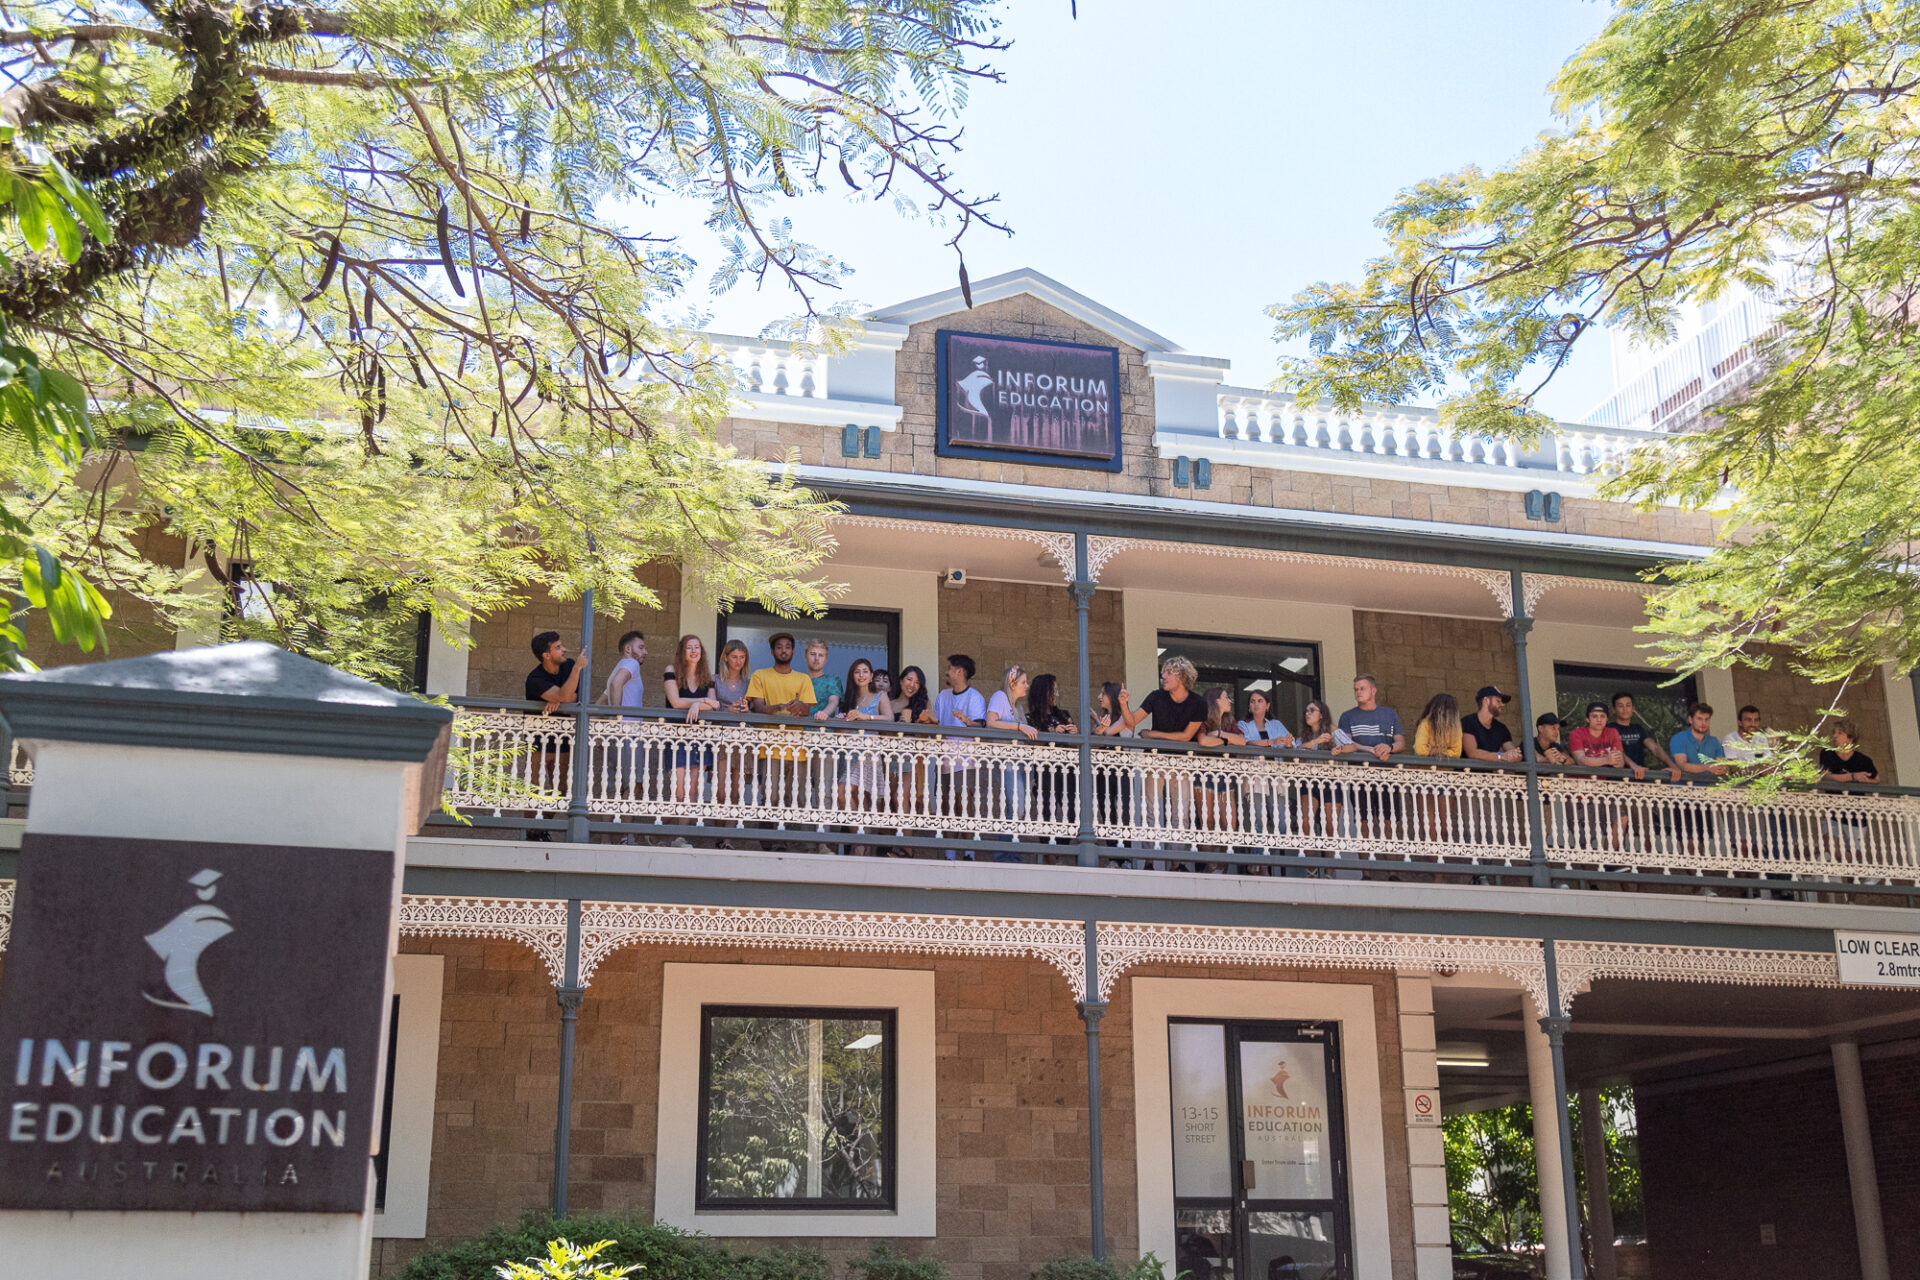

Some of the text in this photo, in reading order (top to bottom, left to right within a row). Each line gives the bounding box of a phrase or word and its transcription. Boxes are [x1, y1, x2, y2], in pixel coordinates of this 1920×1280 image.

[997, 369, 1107, 396] INFORUM
[998, 391, 1108, 414] EDUCATION
[1839, 939, 1920, 957] LOW CLEAR
[15, 1037, 348, 1094] INFORUM
[1181, 1106, 1219, 1120] 13-15
[1247, 1104, 1321, 1119] INFORUM
[9, 1101, 347, 1148] EDUCATION
[1185, 1122, 1215, 1132] SHORT
[1248, 1121, 1323, 1133] EDUCATION
[1185, 1134, 1216, 1144] STREET
[47, 1160, 298, 1184] AUSTRALIA
